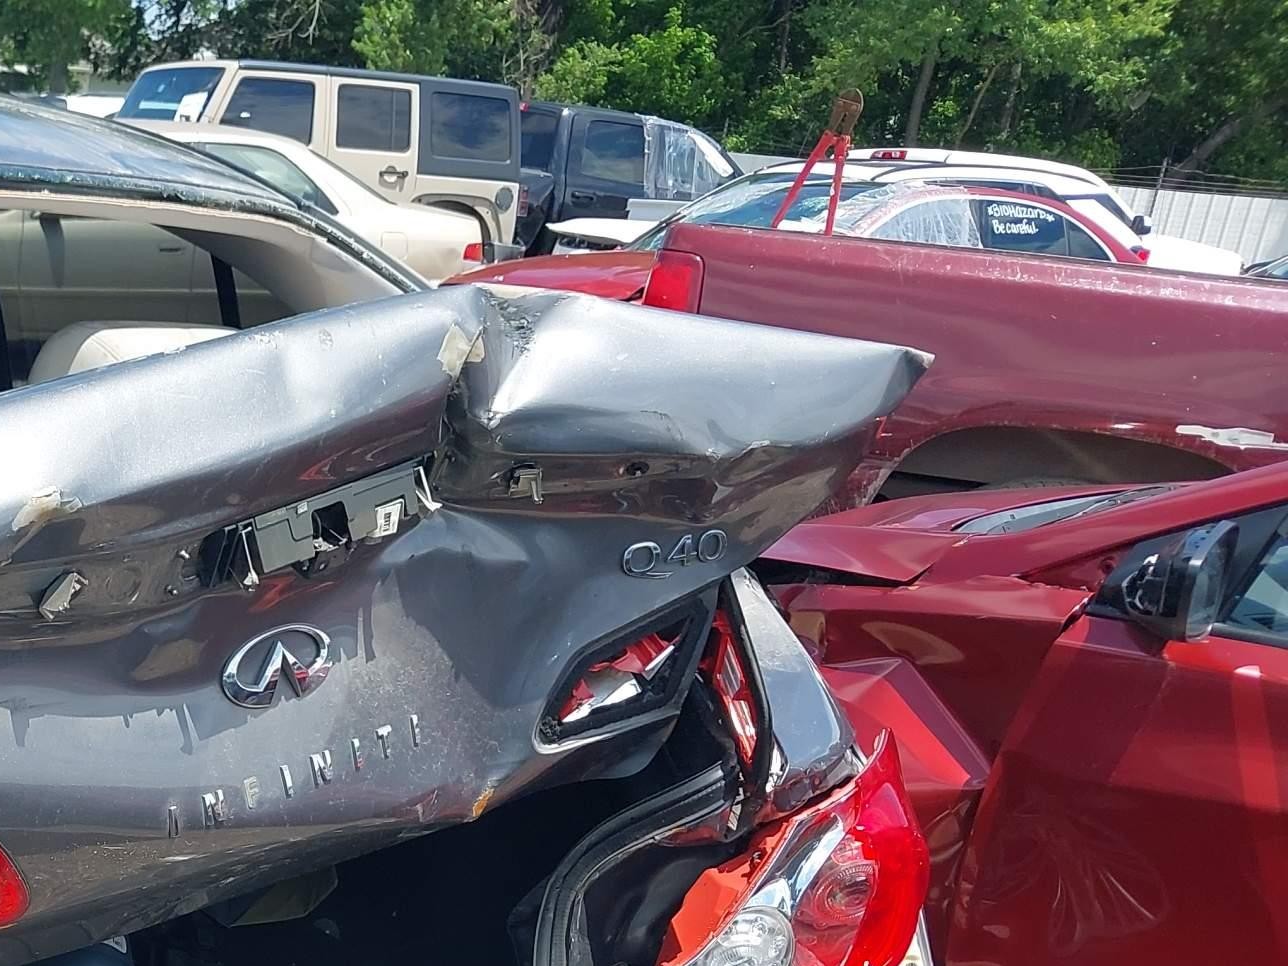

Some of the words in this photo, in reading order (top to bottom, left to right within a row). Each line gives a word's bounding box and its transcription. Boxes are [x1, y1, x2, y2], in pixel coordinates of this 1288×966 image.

[992, 219, 1006, 234] Be
[622, 529, 727, 579] Q40
[168, 714, 419, 838] INFINITI
